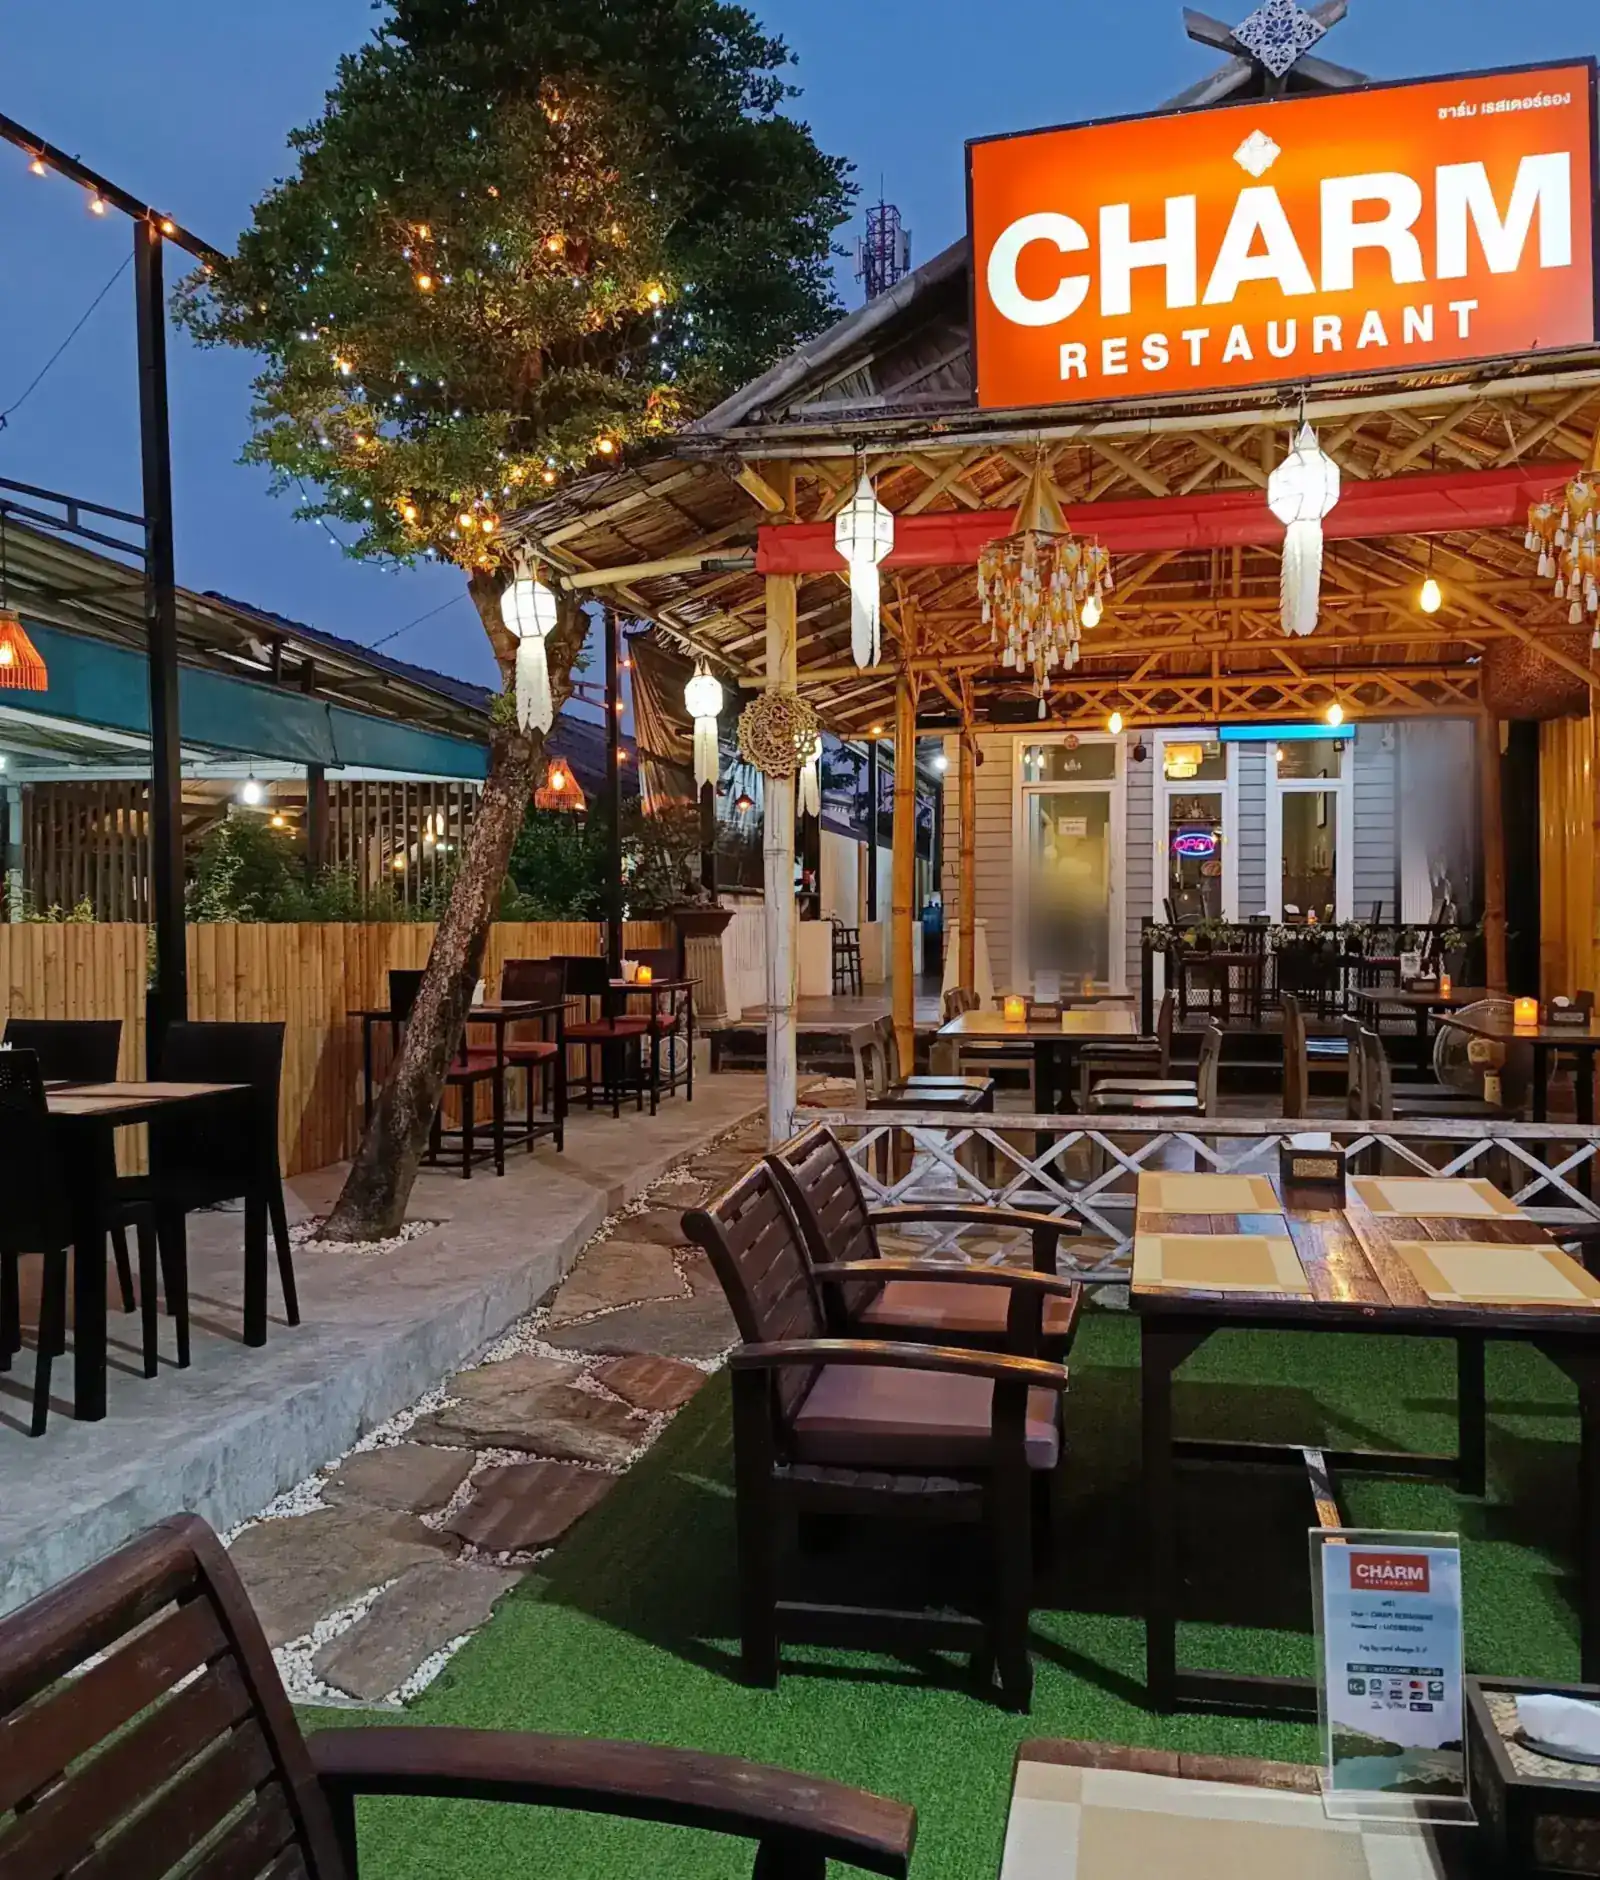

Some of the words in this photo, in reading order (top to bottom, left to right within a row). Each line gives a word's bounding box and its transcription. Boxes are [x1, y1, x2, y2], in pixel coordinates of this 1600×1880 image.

[1437, 100, 1477, 119] ชาร์ม
[986, 151, 1573, 328] CHARM
[1059, 299, 1479, 380] RESTAURANT
[1174, 838, 1215, 851] OPEN
[1356, 1563, 1424, 1580] CHARM
